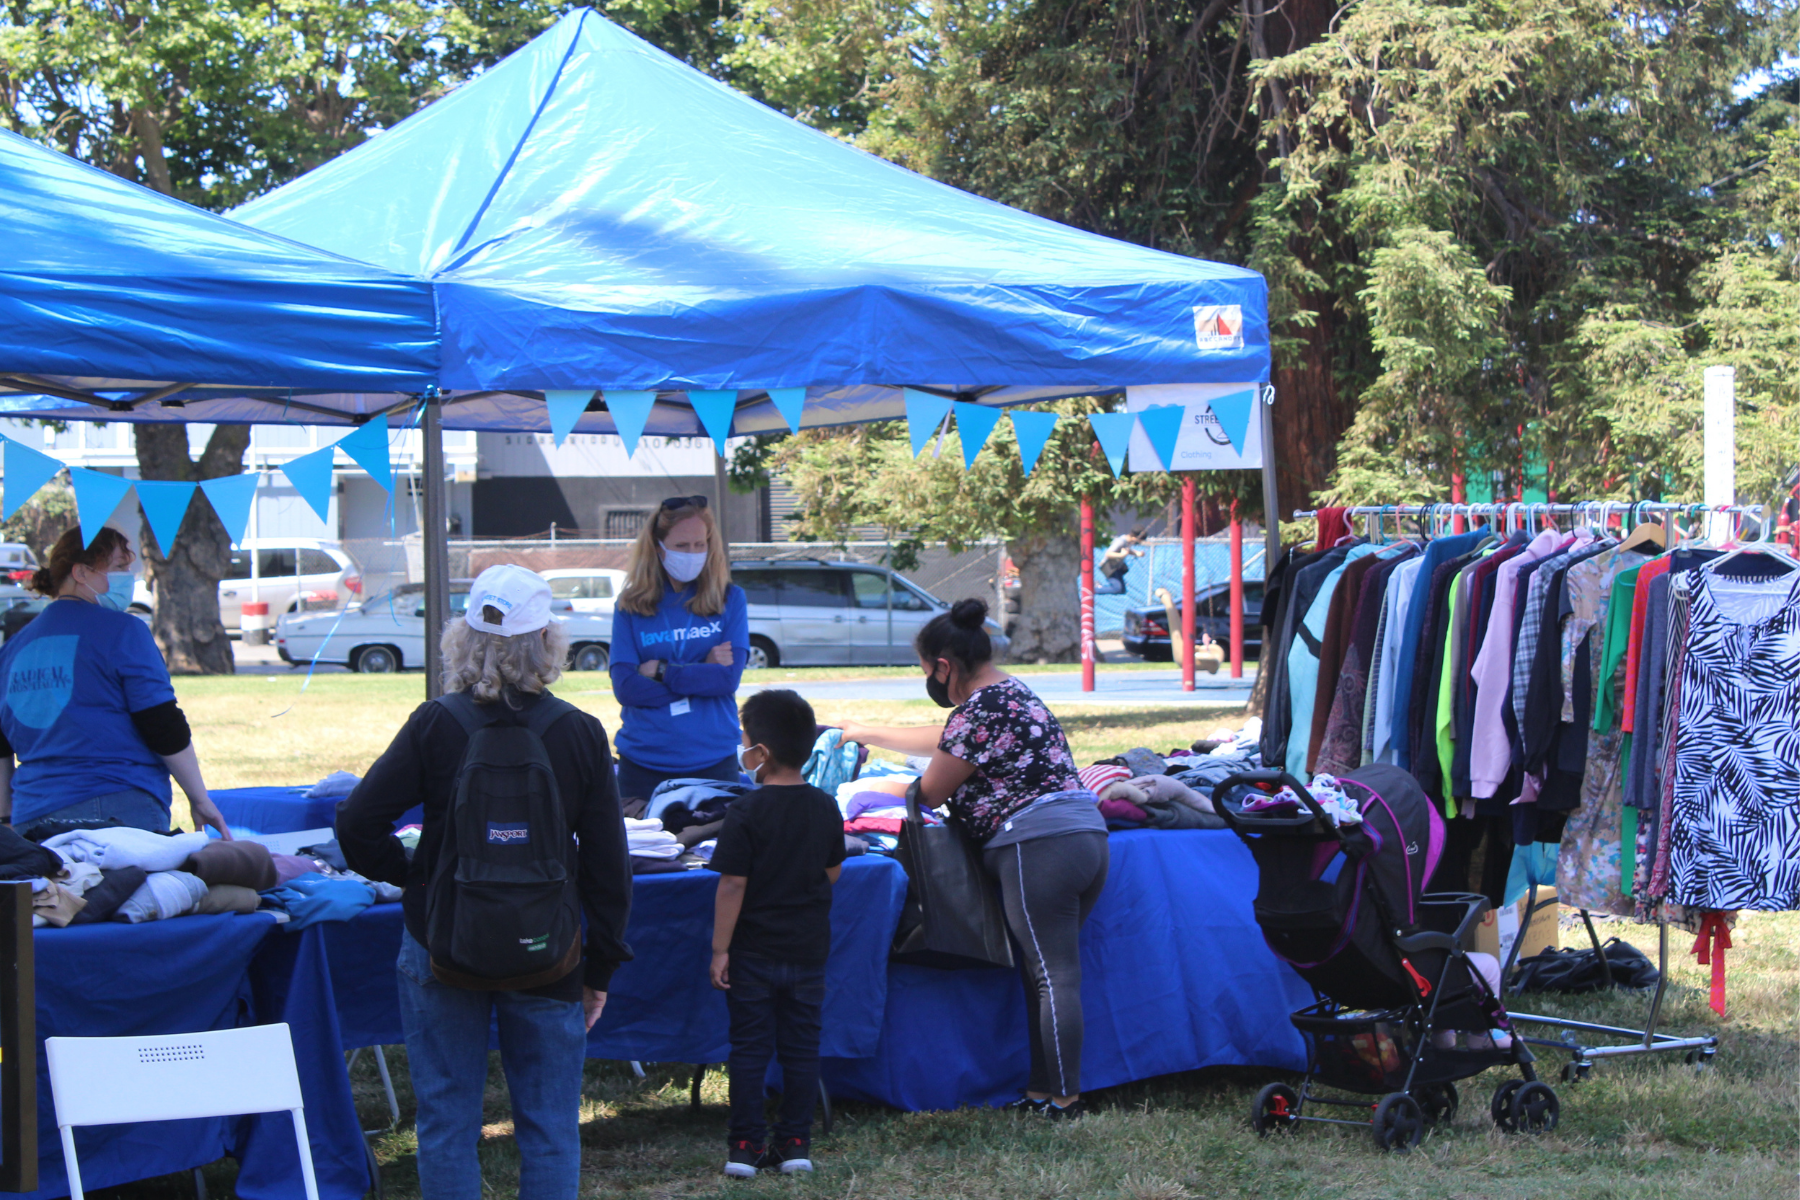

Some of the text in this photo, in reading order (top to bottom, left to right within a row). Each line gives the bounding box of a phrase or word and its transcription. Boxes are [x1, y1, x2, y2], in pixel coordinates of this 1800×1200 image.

[1194, 415, 1220, 424] STREE
[1180, 450, 1212, 459] Clothing
[640, 620, 722, 647] lavamaex
[11, 666, 64, 684] RADICAL
